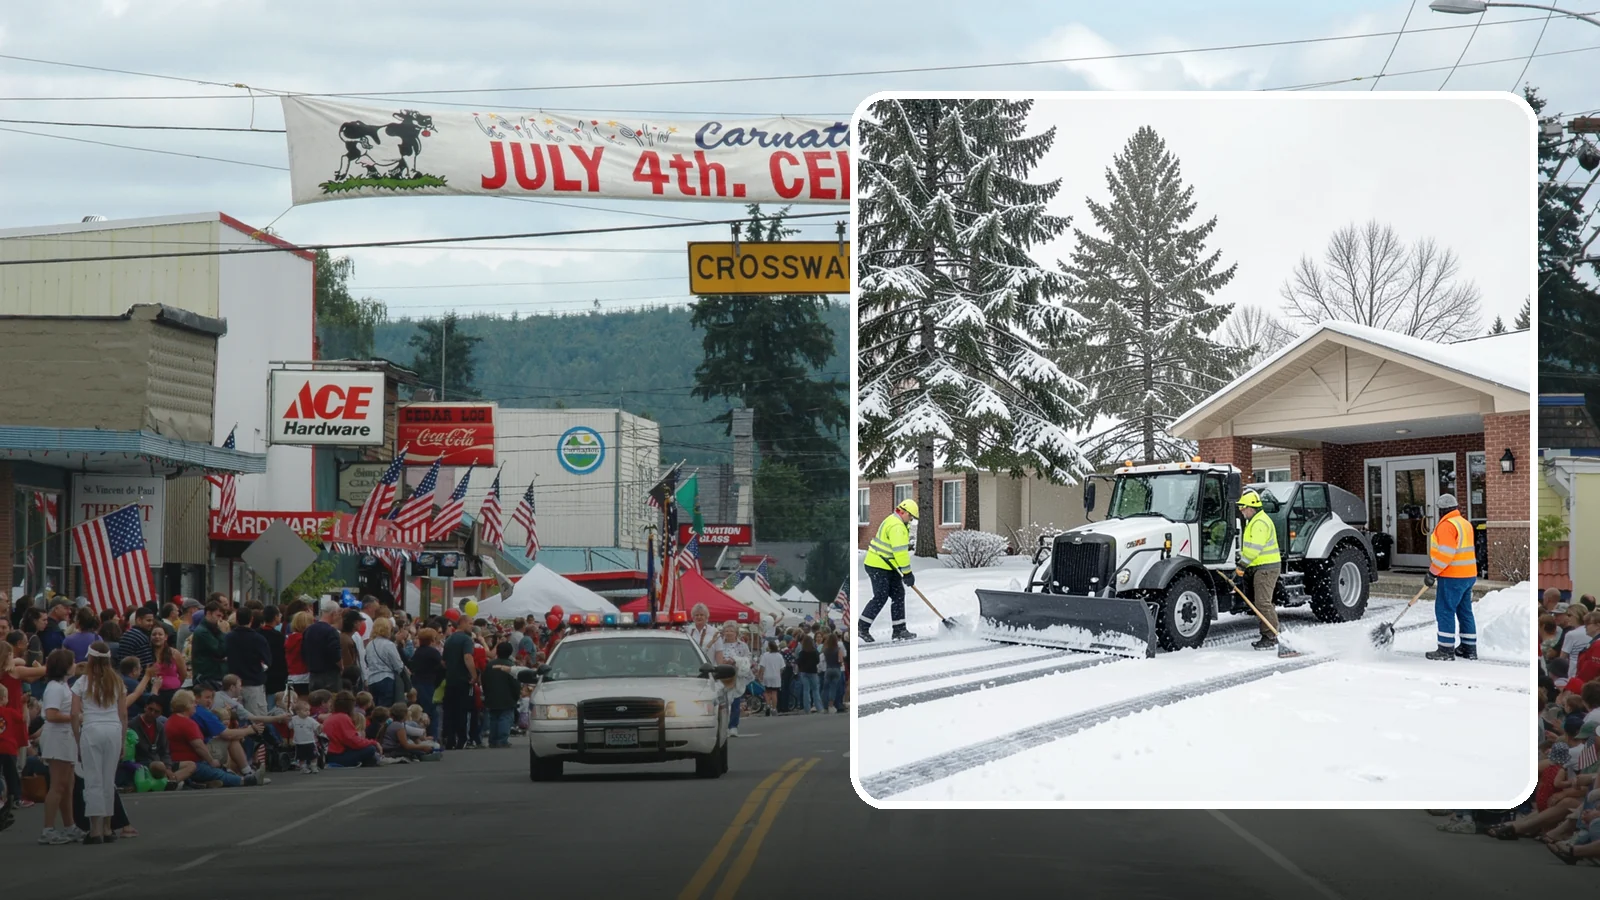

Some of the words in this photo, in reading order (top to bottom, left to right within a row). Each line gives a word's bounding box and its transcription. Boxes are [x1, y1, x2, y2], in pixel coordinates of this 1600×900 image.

[481, 141, 604, 192] JULY
[633, 150, 746, 198] 4th.
[697, 254, 850, 280] CROSSWA
[283, 380, 373, 420] ACE
[406, 409, 453, 421] CEDAR
[284, 421, 371, 436] Hardware
[416, 428, 477, 447] Coca-Cola
[353, 467, 385, 480] Simpl
[83, 485, 93, 494] St.
[96, 485, 124, 495] Vincent
[126, 486, 135, 495] de
[138, 486, 155, 495] Paul
[213, 516, 330, 534] HARDARE
[688, 526, 741, 535] CRNATION
[699, 535, 730, 543] GLASS
